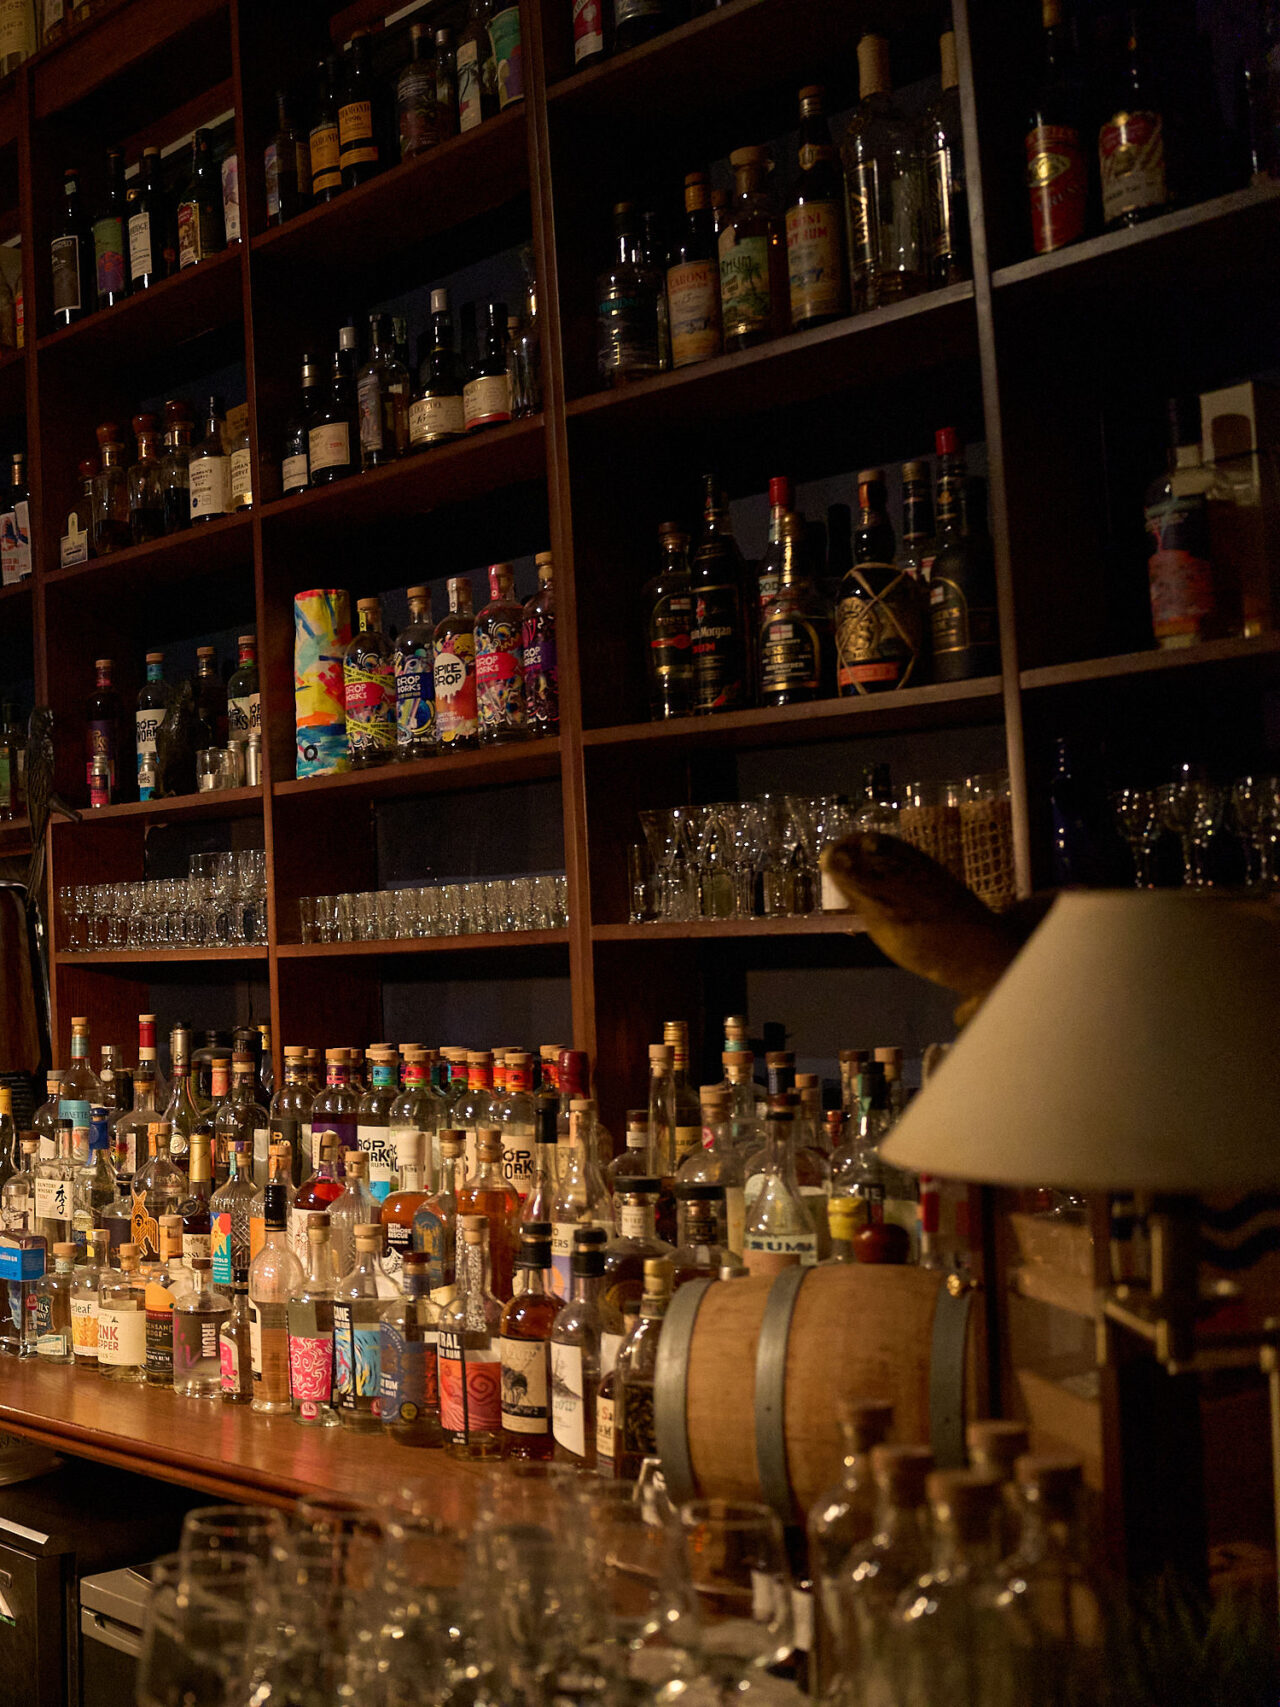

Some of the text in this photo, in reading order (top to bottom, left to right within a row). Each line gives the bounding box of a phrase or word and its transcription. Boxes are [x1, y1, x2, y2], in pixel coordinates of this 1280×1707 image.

[434, 662, 461, 677] SPICE
[55, 1183, 67, 1215] 季
[99, 1324, 119, 1341] INK
[201, 1328, 217, 1357] RUM
